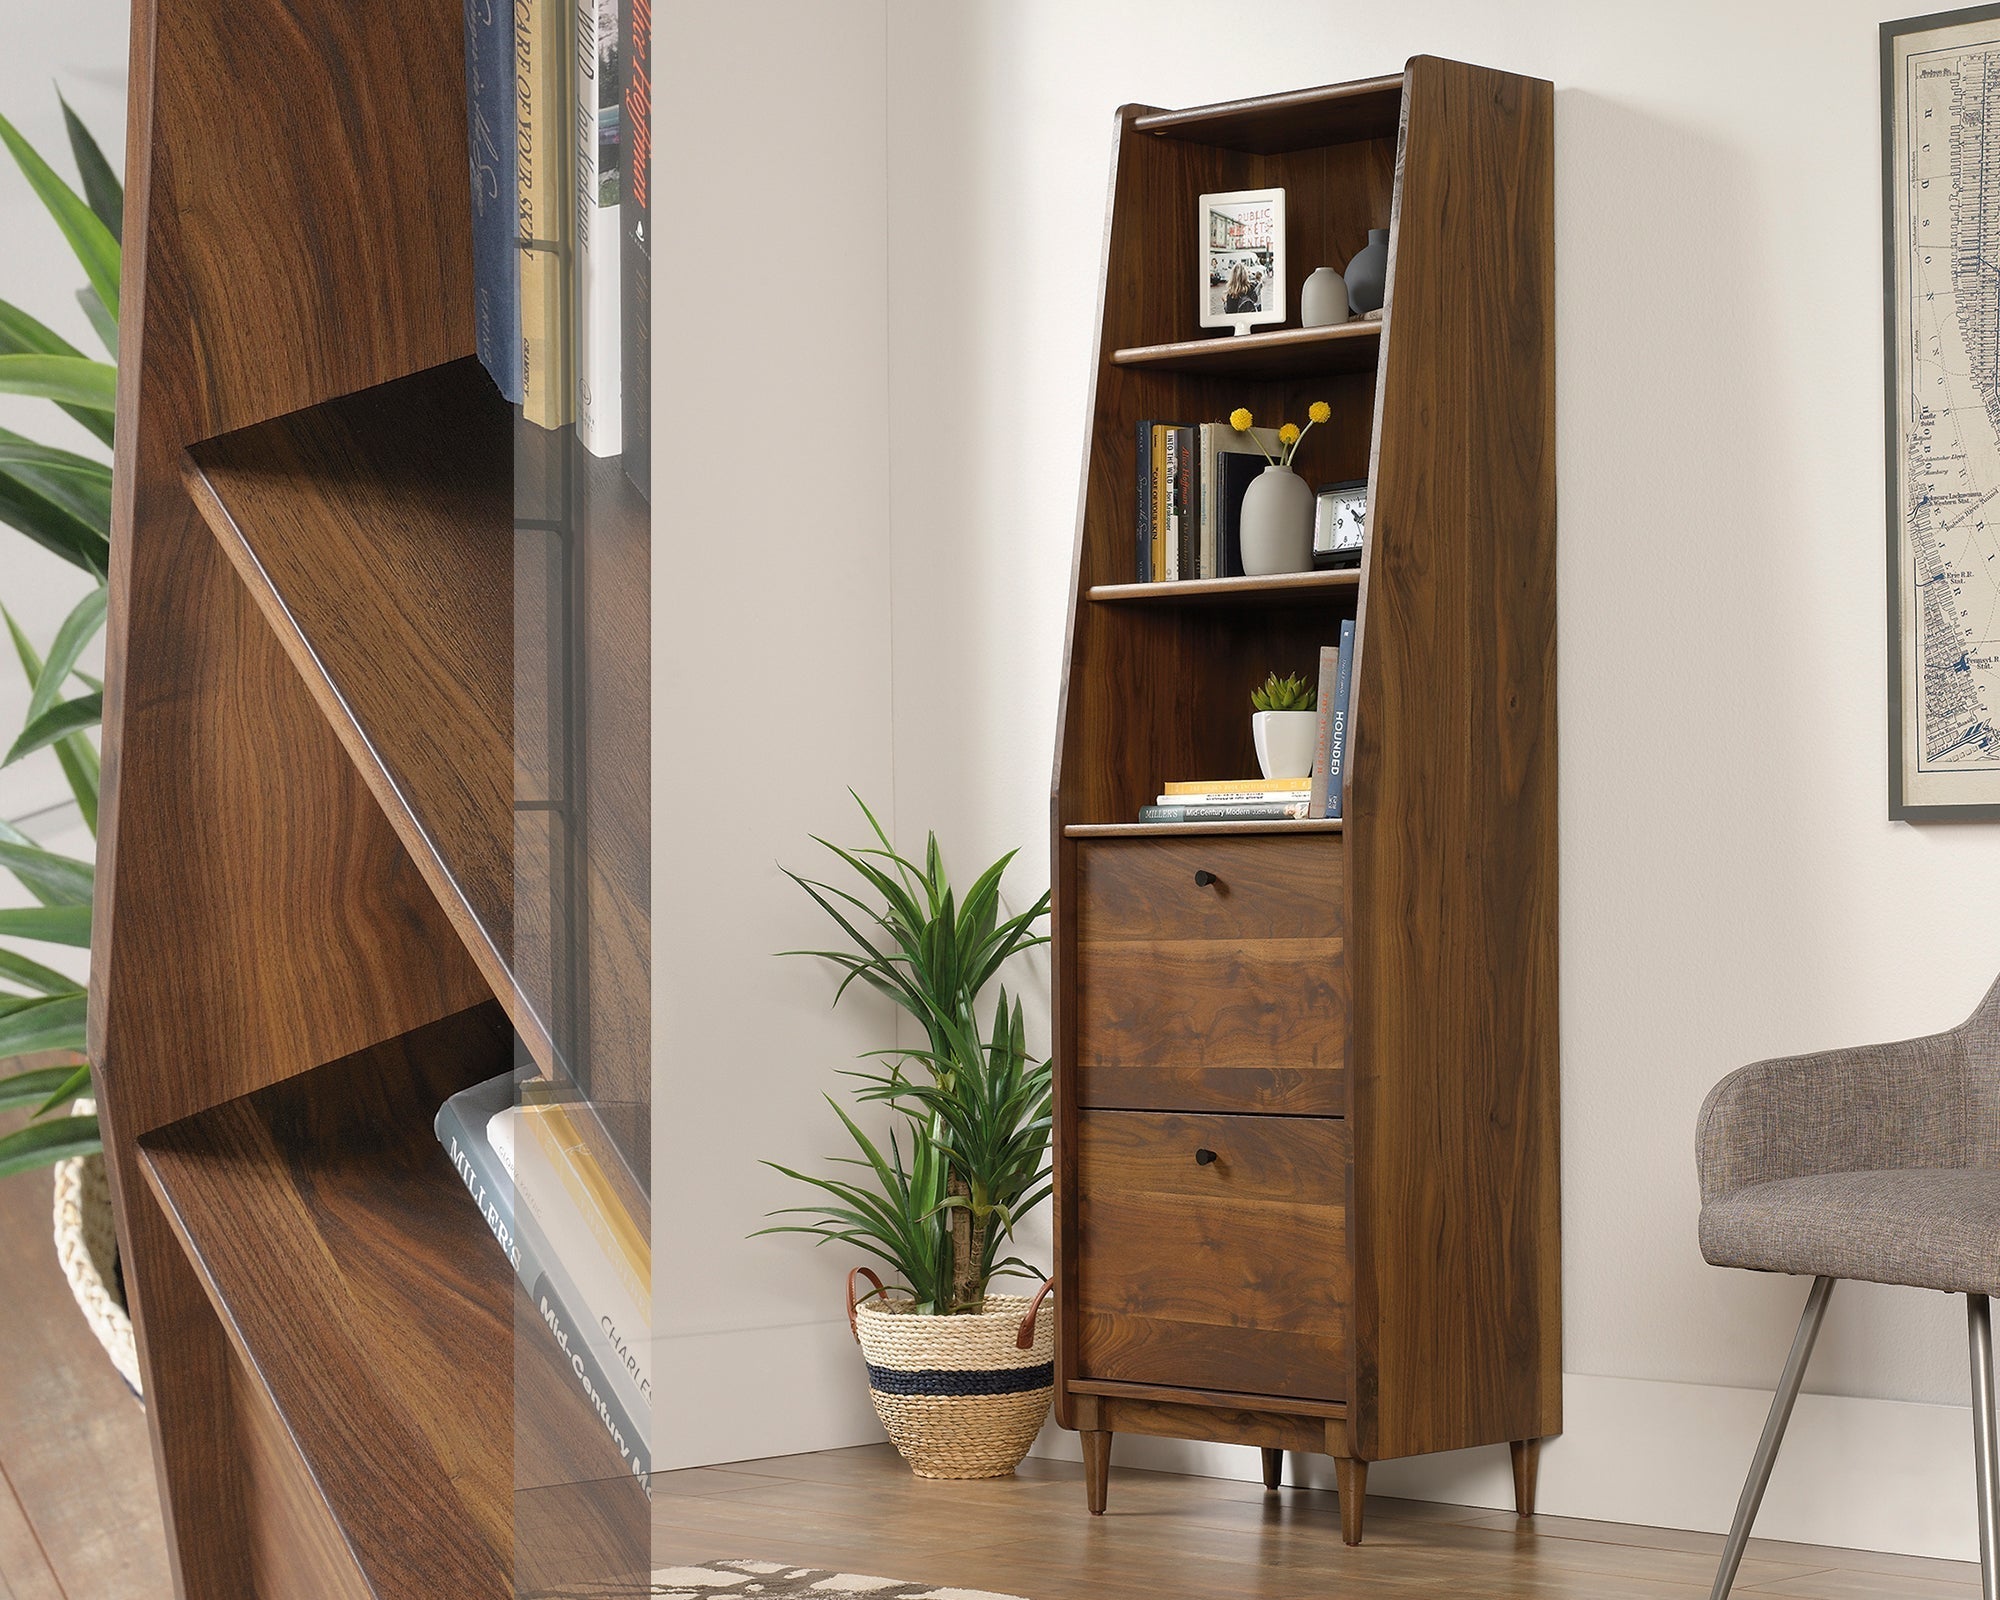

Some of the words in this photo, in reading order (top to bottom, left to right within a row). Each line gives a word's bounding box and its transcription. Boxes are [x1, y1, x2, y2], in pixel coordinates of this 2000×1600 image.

[577, 4, 595, 80] WILD
[516, 75, 532, 115] OF
[577, 94, 594, 142] Jon
[517, 115, 533, 194] YOUR
[519, 196, 534, 261] SKIN
[1182, 447, 1190, 466] Alice
[1180, 467, 1190, 505] Hoffman
[1331, 711, 1344, 775] HOUNDED
[1226, 805, 1250, 815] Modern
[450, 1136, 522, 1272] MILLER'S
[540, 1295, 630, 1458] Mid-Century
